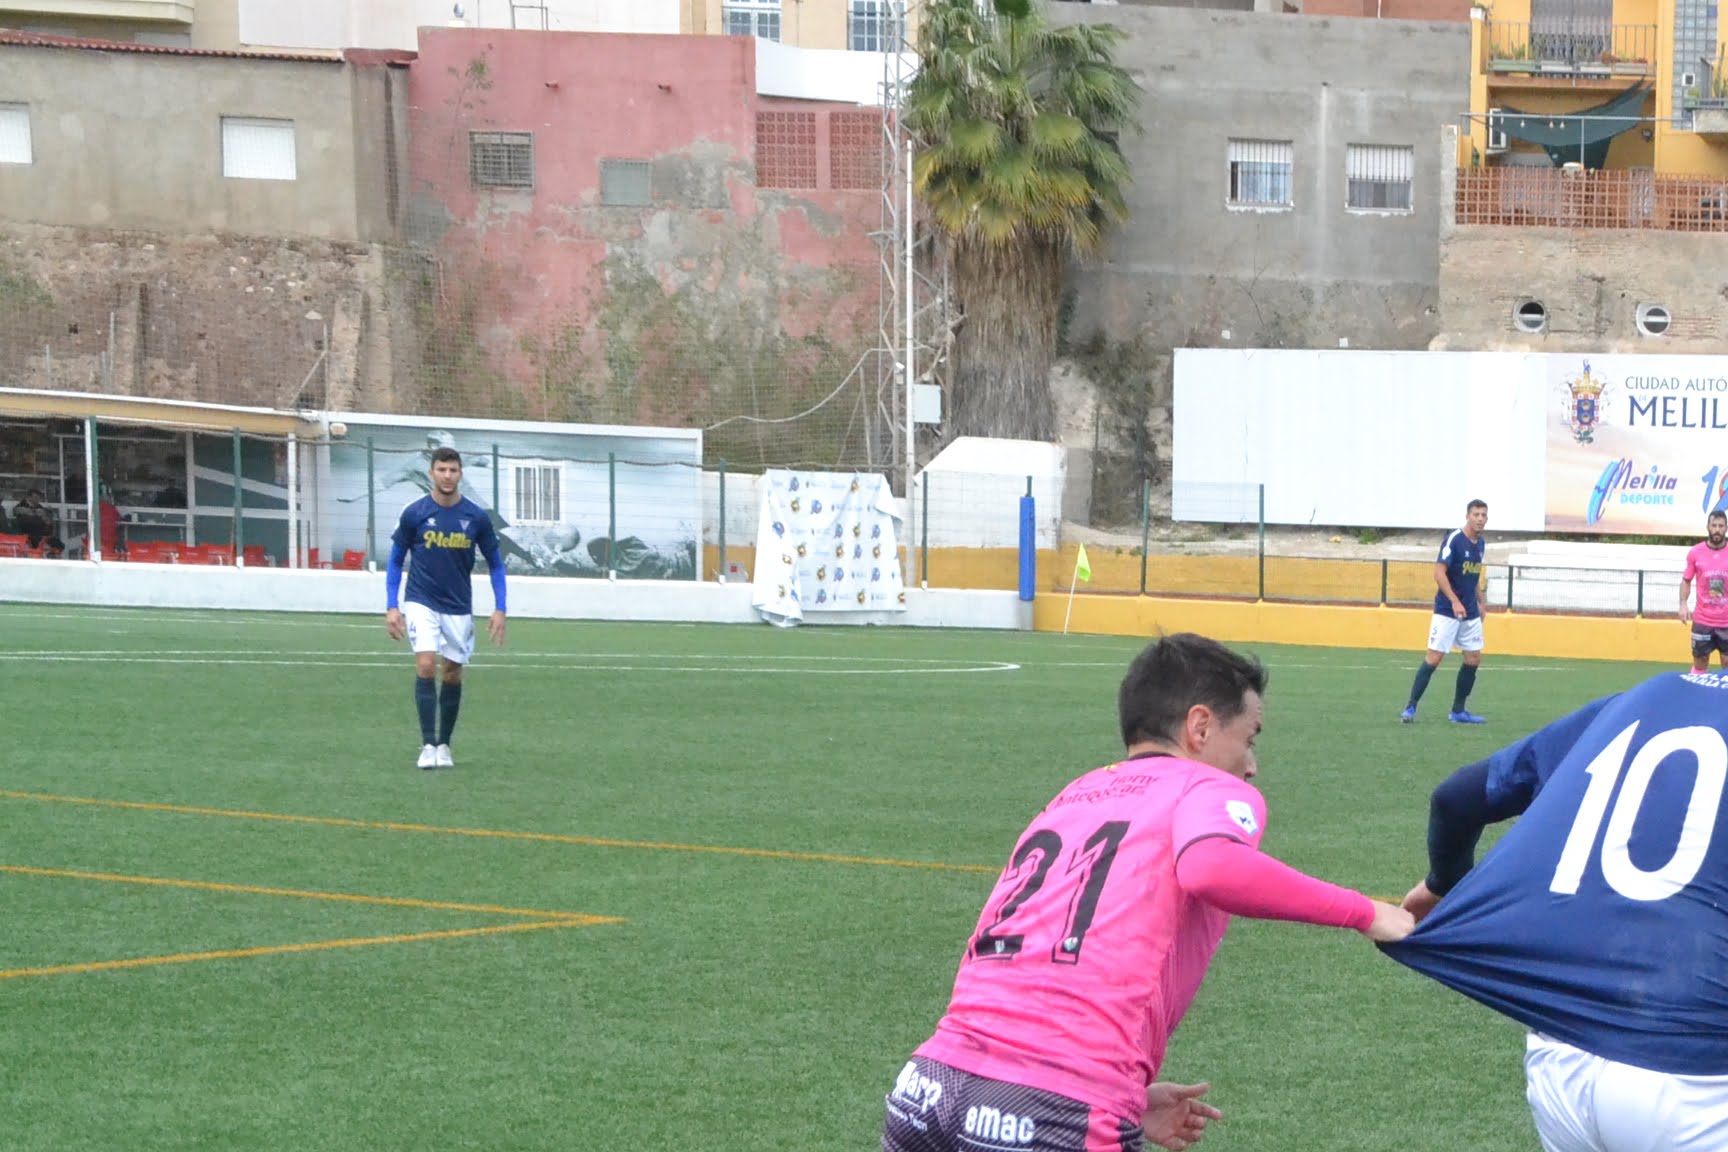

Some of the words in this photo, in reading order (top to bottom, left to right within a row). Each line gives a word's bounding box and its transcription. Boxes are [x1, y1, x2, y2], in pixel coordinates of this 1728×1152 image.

[1625, 376, 1680, 390] CIUDAD
[1620, 494, 1674, 505] DEPORTE
[1549, 719, 1728, 901] 10
[968, 821, 1131, 965] 21
